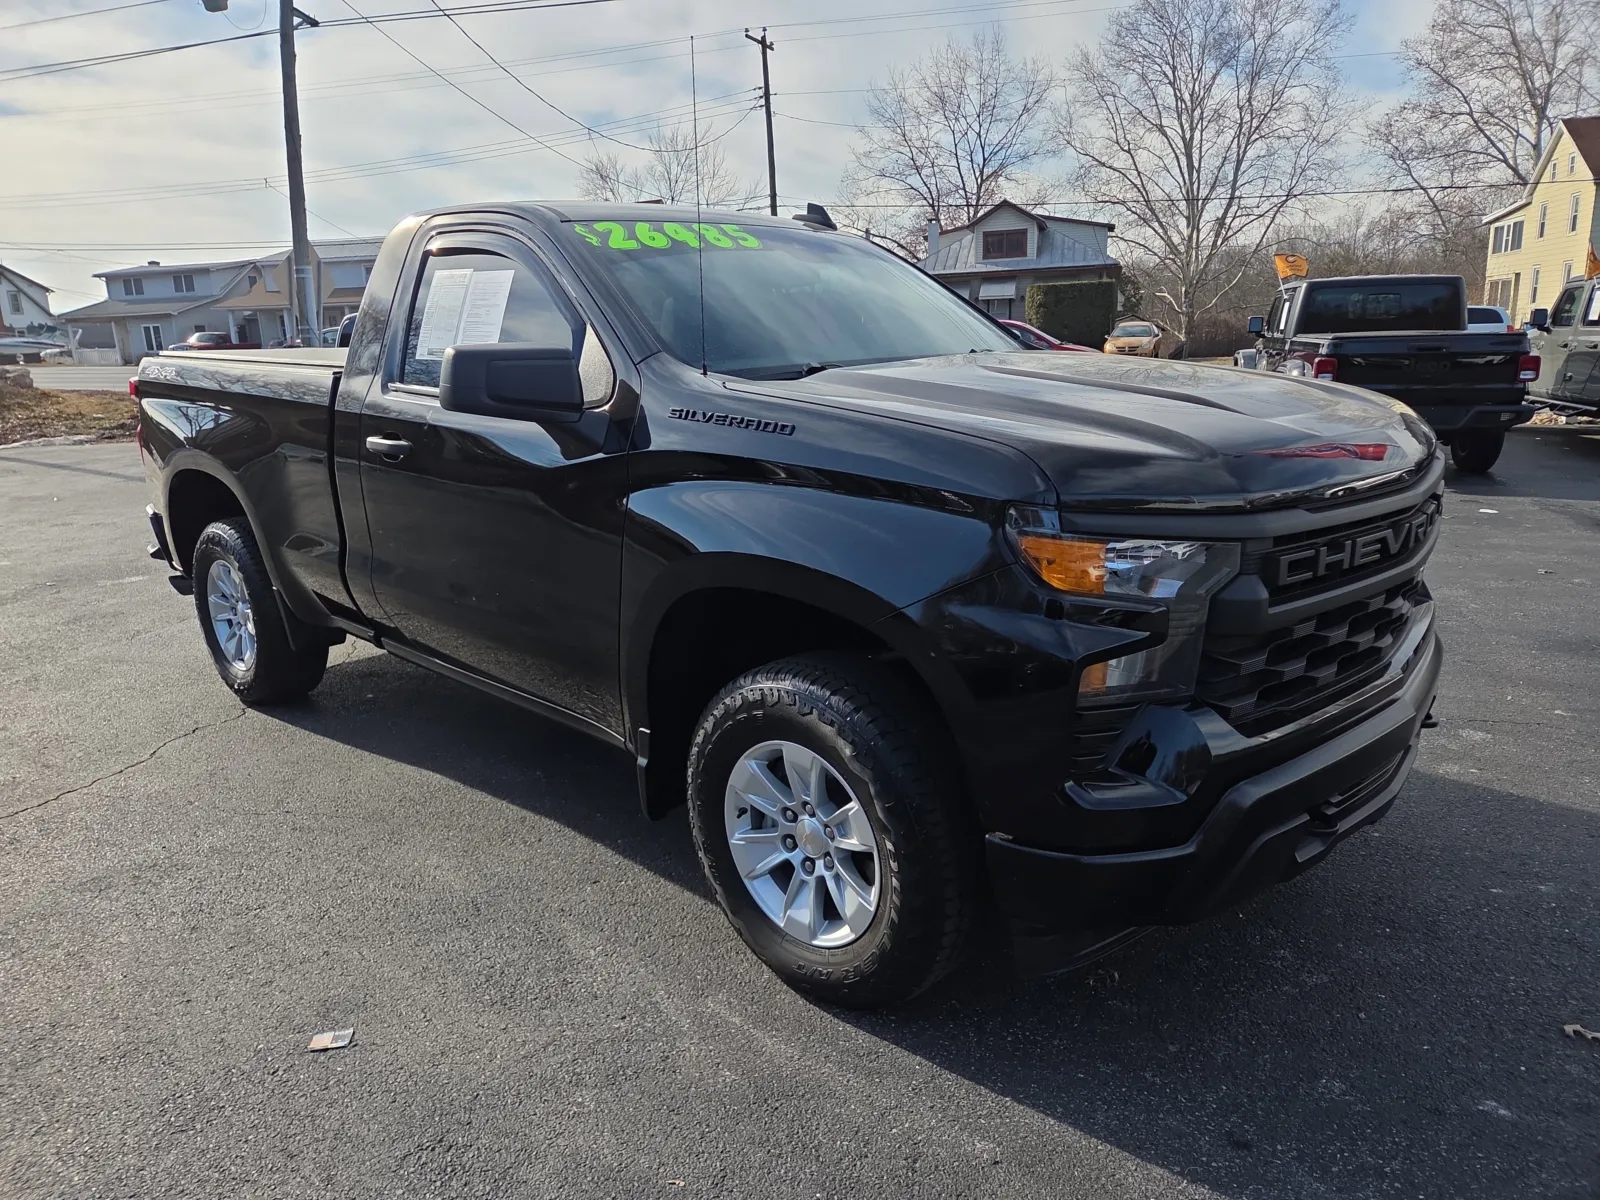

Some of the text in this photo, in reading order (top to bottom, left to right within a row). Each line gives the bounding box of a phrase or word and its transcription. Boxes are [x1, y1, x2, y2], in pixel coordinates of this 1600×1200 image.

[574, 221, 762, 249] $26485
[668, 407, 796, 436] SILVERADO
[842, 834, 901, 984] DUELER
